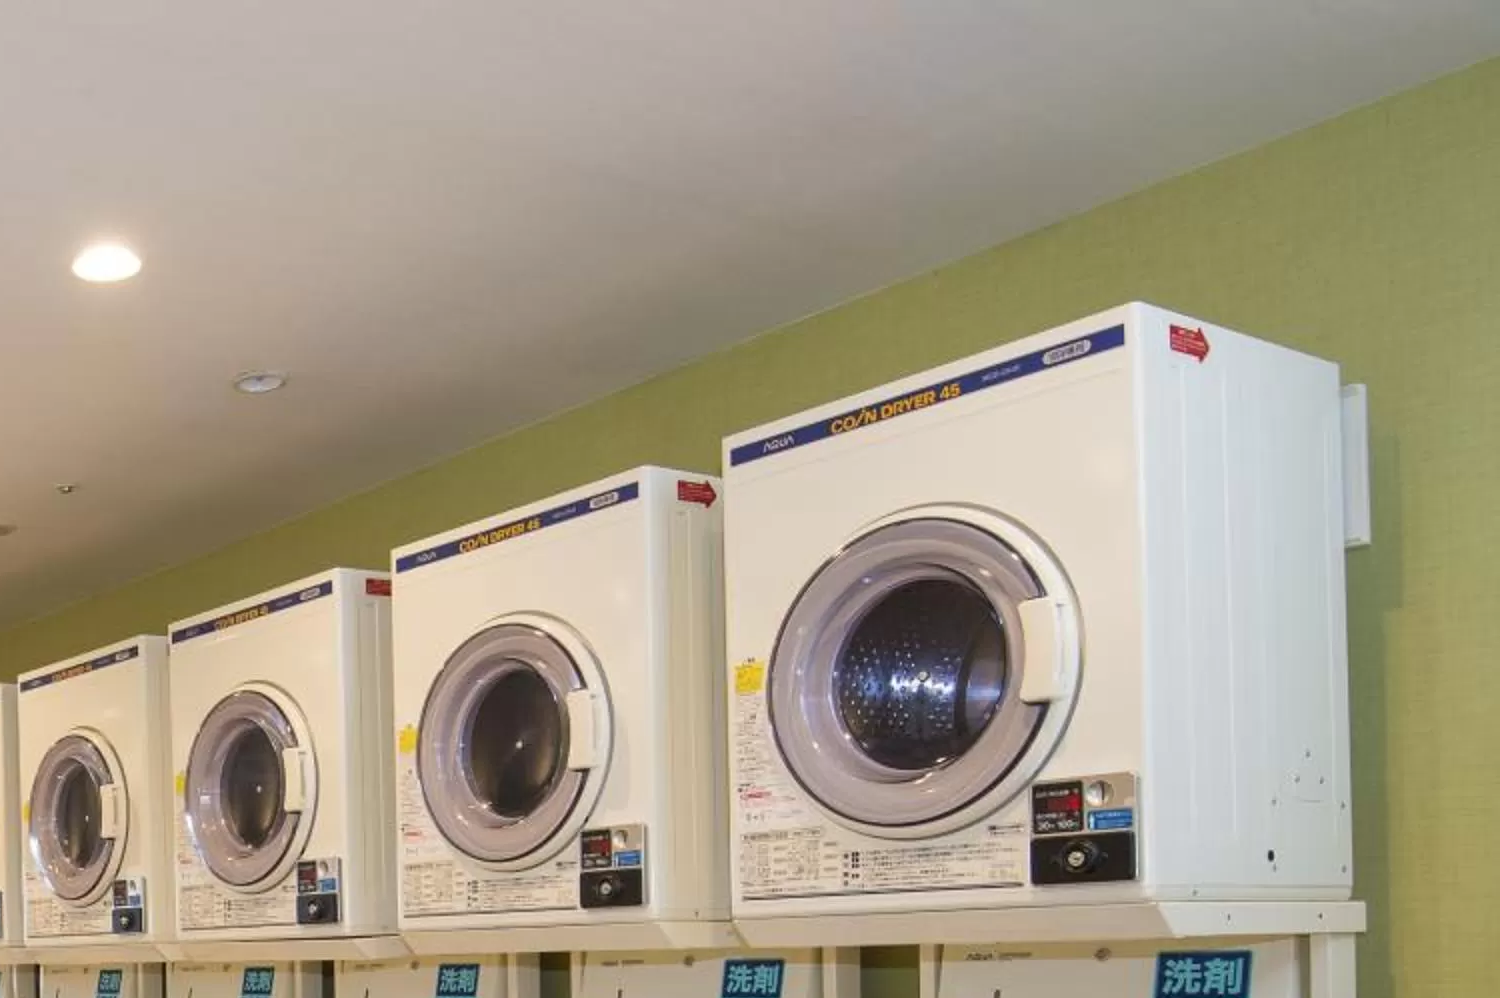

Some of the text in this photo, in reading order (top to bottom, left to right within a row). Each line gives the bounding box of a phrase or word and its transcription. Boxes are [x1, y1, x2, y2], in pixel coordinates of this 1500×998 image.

[881, 391, 936, 418] DRYER
[939, 382, 962, 399] 45
[725, 964, 779, 994] 洗剤
[1162, 957, 1243, 996] 洗剤
